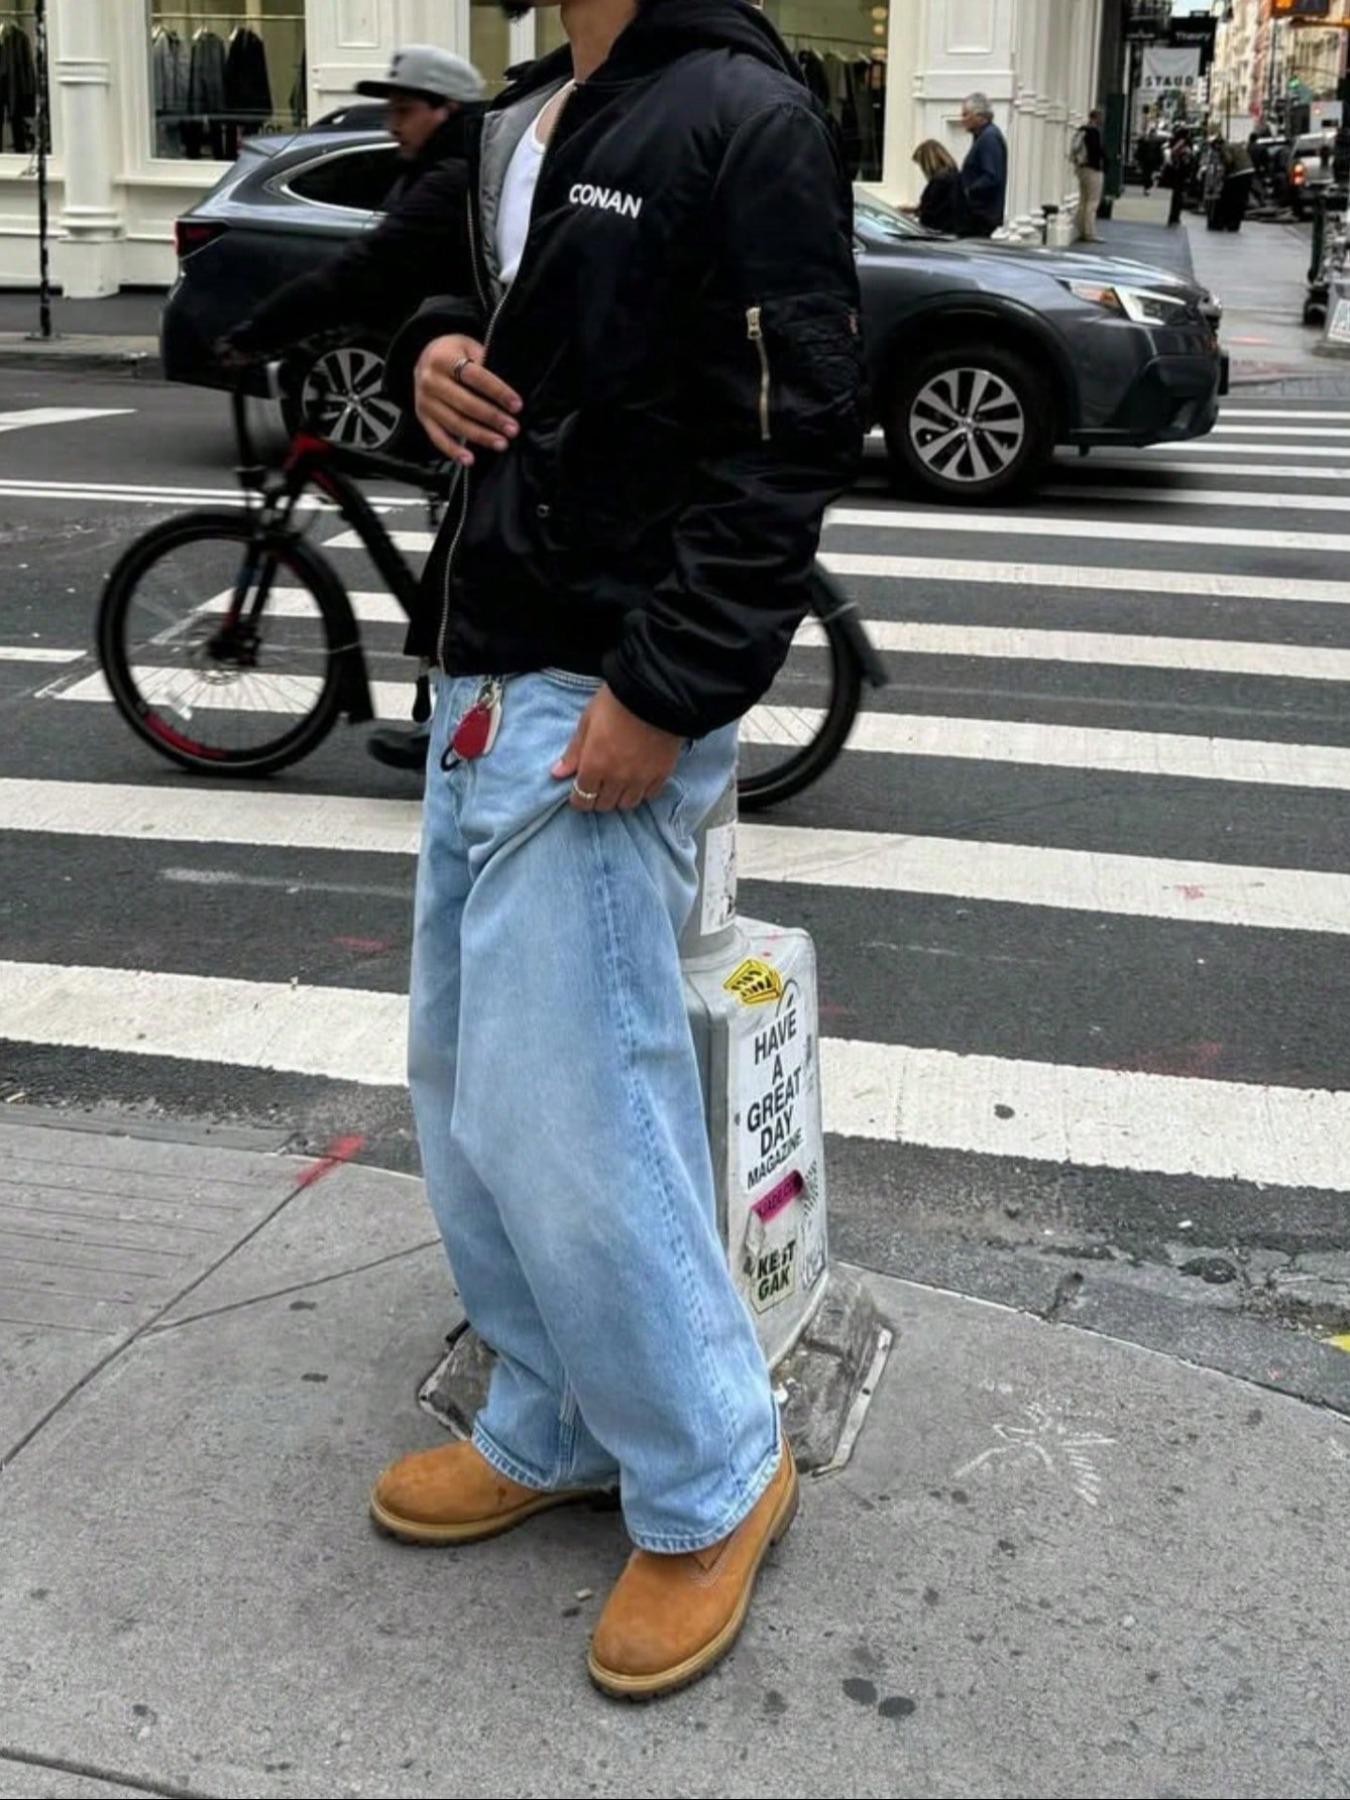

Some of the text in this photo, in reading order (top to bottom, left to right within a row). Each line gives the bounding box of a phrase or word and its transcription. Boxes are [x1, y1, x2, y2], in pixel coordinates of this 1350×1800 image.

[569, 184, 642, 219] CONAN
[754, 1008, 797, 1066] HAVE
[772, 1054, 783, 1085] A
[747, 1066, 801, 1133] GREAT
[761, 1104, 793, 1157] DAY
[747, 1127, 803, 1190] MAGAZINE
[758, 1265, 790, 1301] GAK
